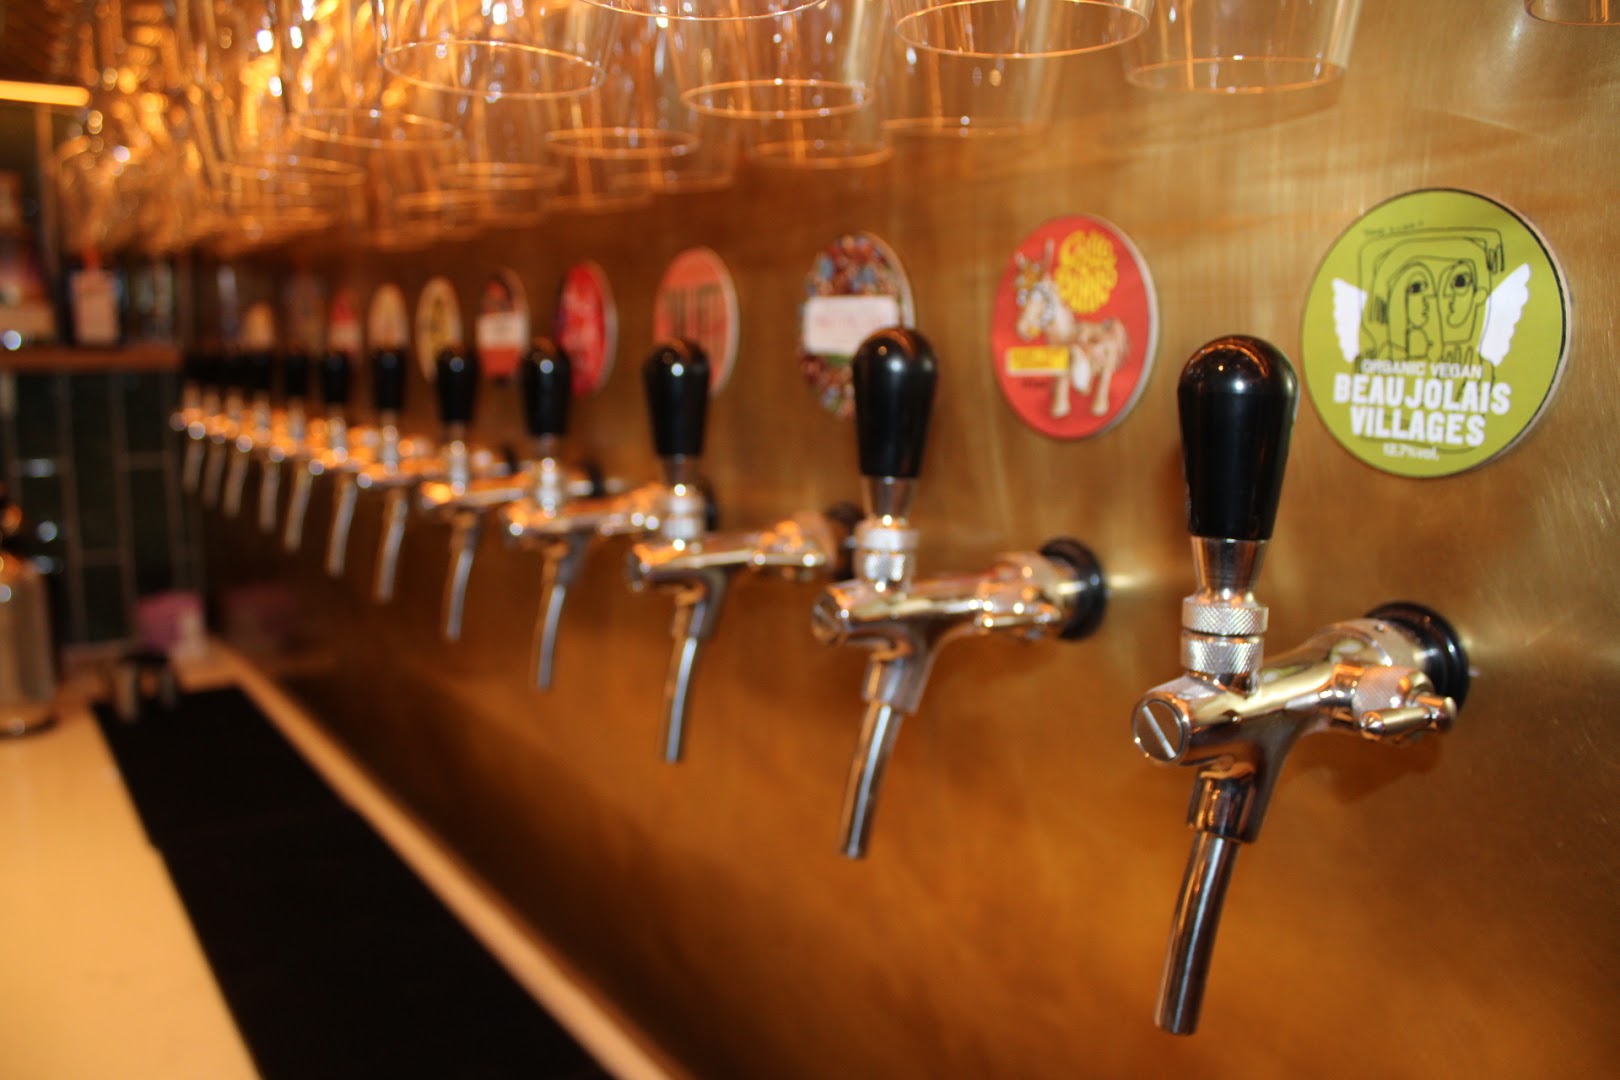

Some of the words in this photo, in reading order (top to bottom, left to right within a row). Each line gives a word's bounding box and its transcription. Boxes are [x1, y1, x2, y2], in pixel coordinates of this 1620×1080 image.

[1361, 358, 1426, 377] ORGANIC
[1430, 362, 1484, 379] VEGAN
[1333, 373, 1512, 415] BEAUJOLAIS
[1349, 405, 1486, 447] VILLAGES
